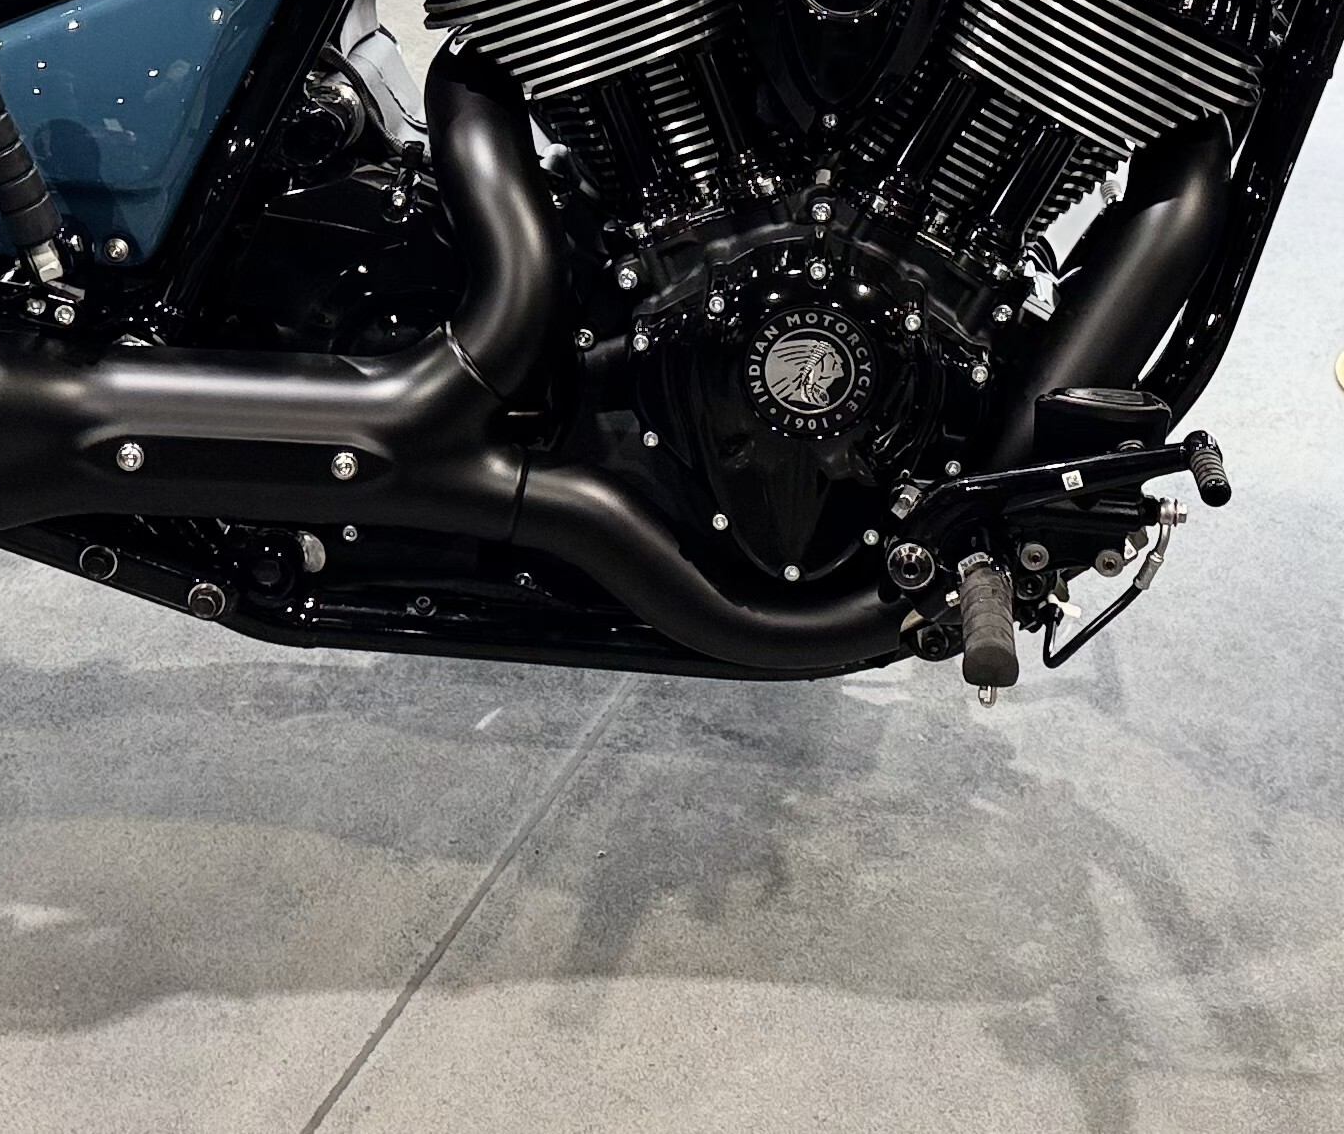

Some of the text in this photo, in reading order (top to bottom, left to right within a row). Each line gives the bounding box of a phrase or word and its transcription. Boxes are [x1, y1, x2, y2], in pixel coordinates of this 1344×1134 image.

[749, 312, 871, 412] INDIAN MOTORCYCLE
[783, 414, 829, 430] 1901
